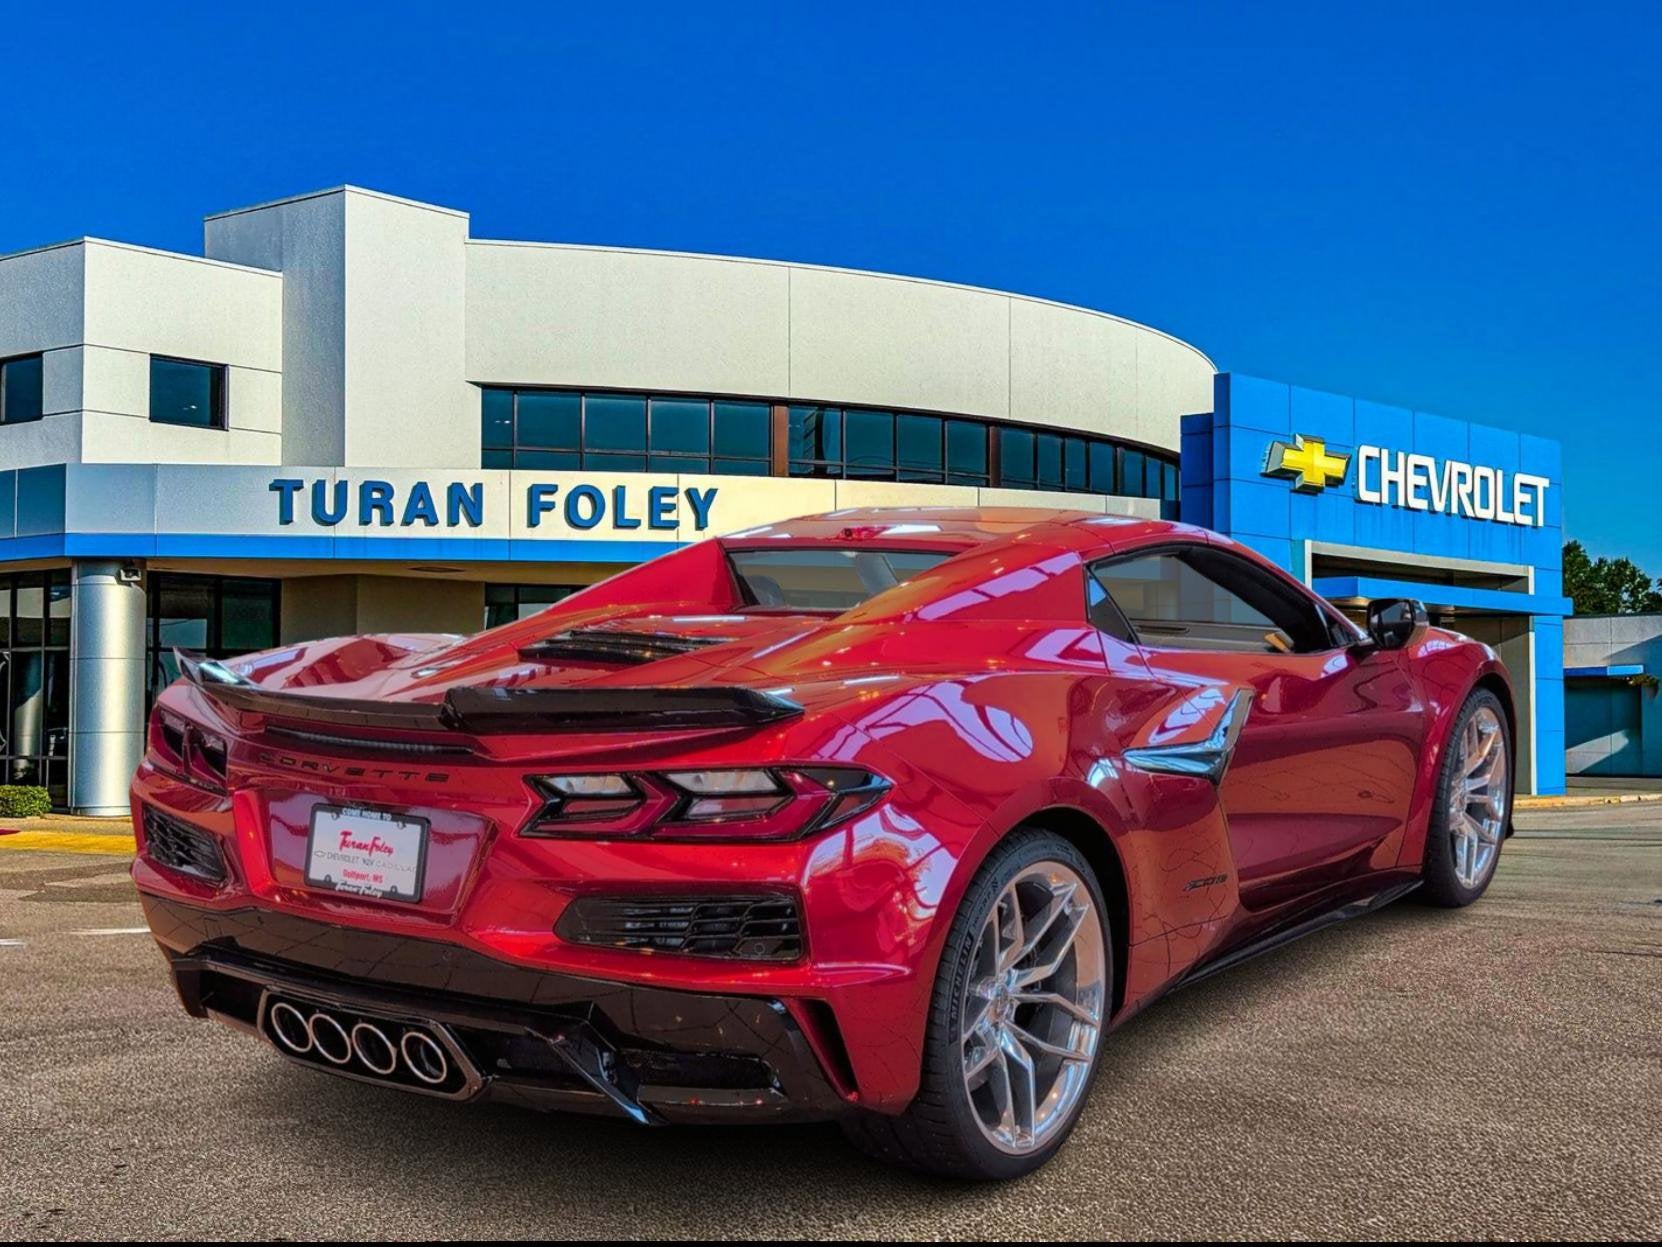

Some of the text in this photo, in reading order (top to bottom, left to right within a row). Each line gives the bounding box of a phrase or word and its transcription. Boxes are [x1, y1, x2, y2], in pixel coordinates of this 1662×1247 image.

[269, 479, 718, 531] TURAN FOLEY
[1358, 444, 1550, 527] CHEVROLET
[259, 752, 449, 782] CORVETTE
[951, 931, 973, 1023] MICHELIN
